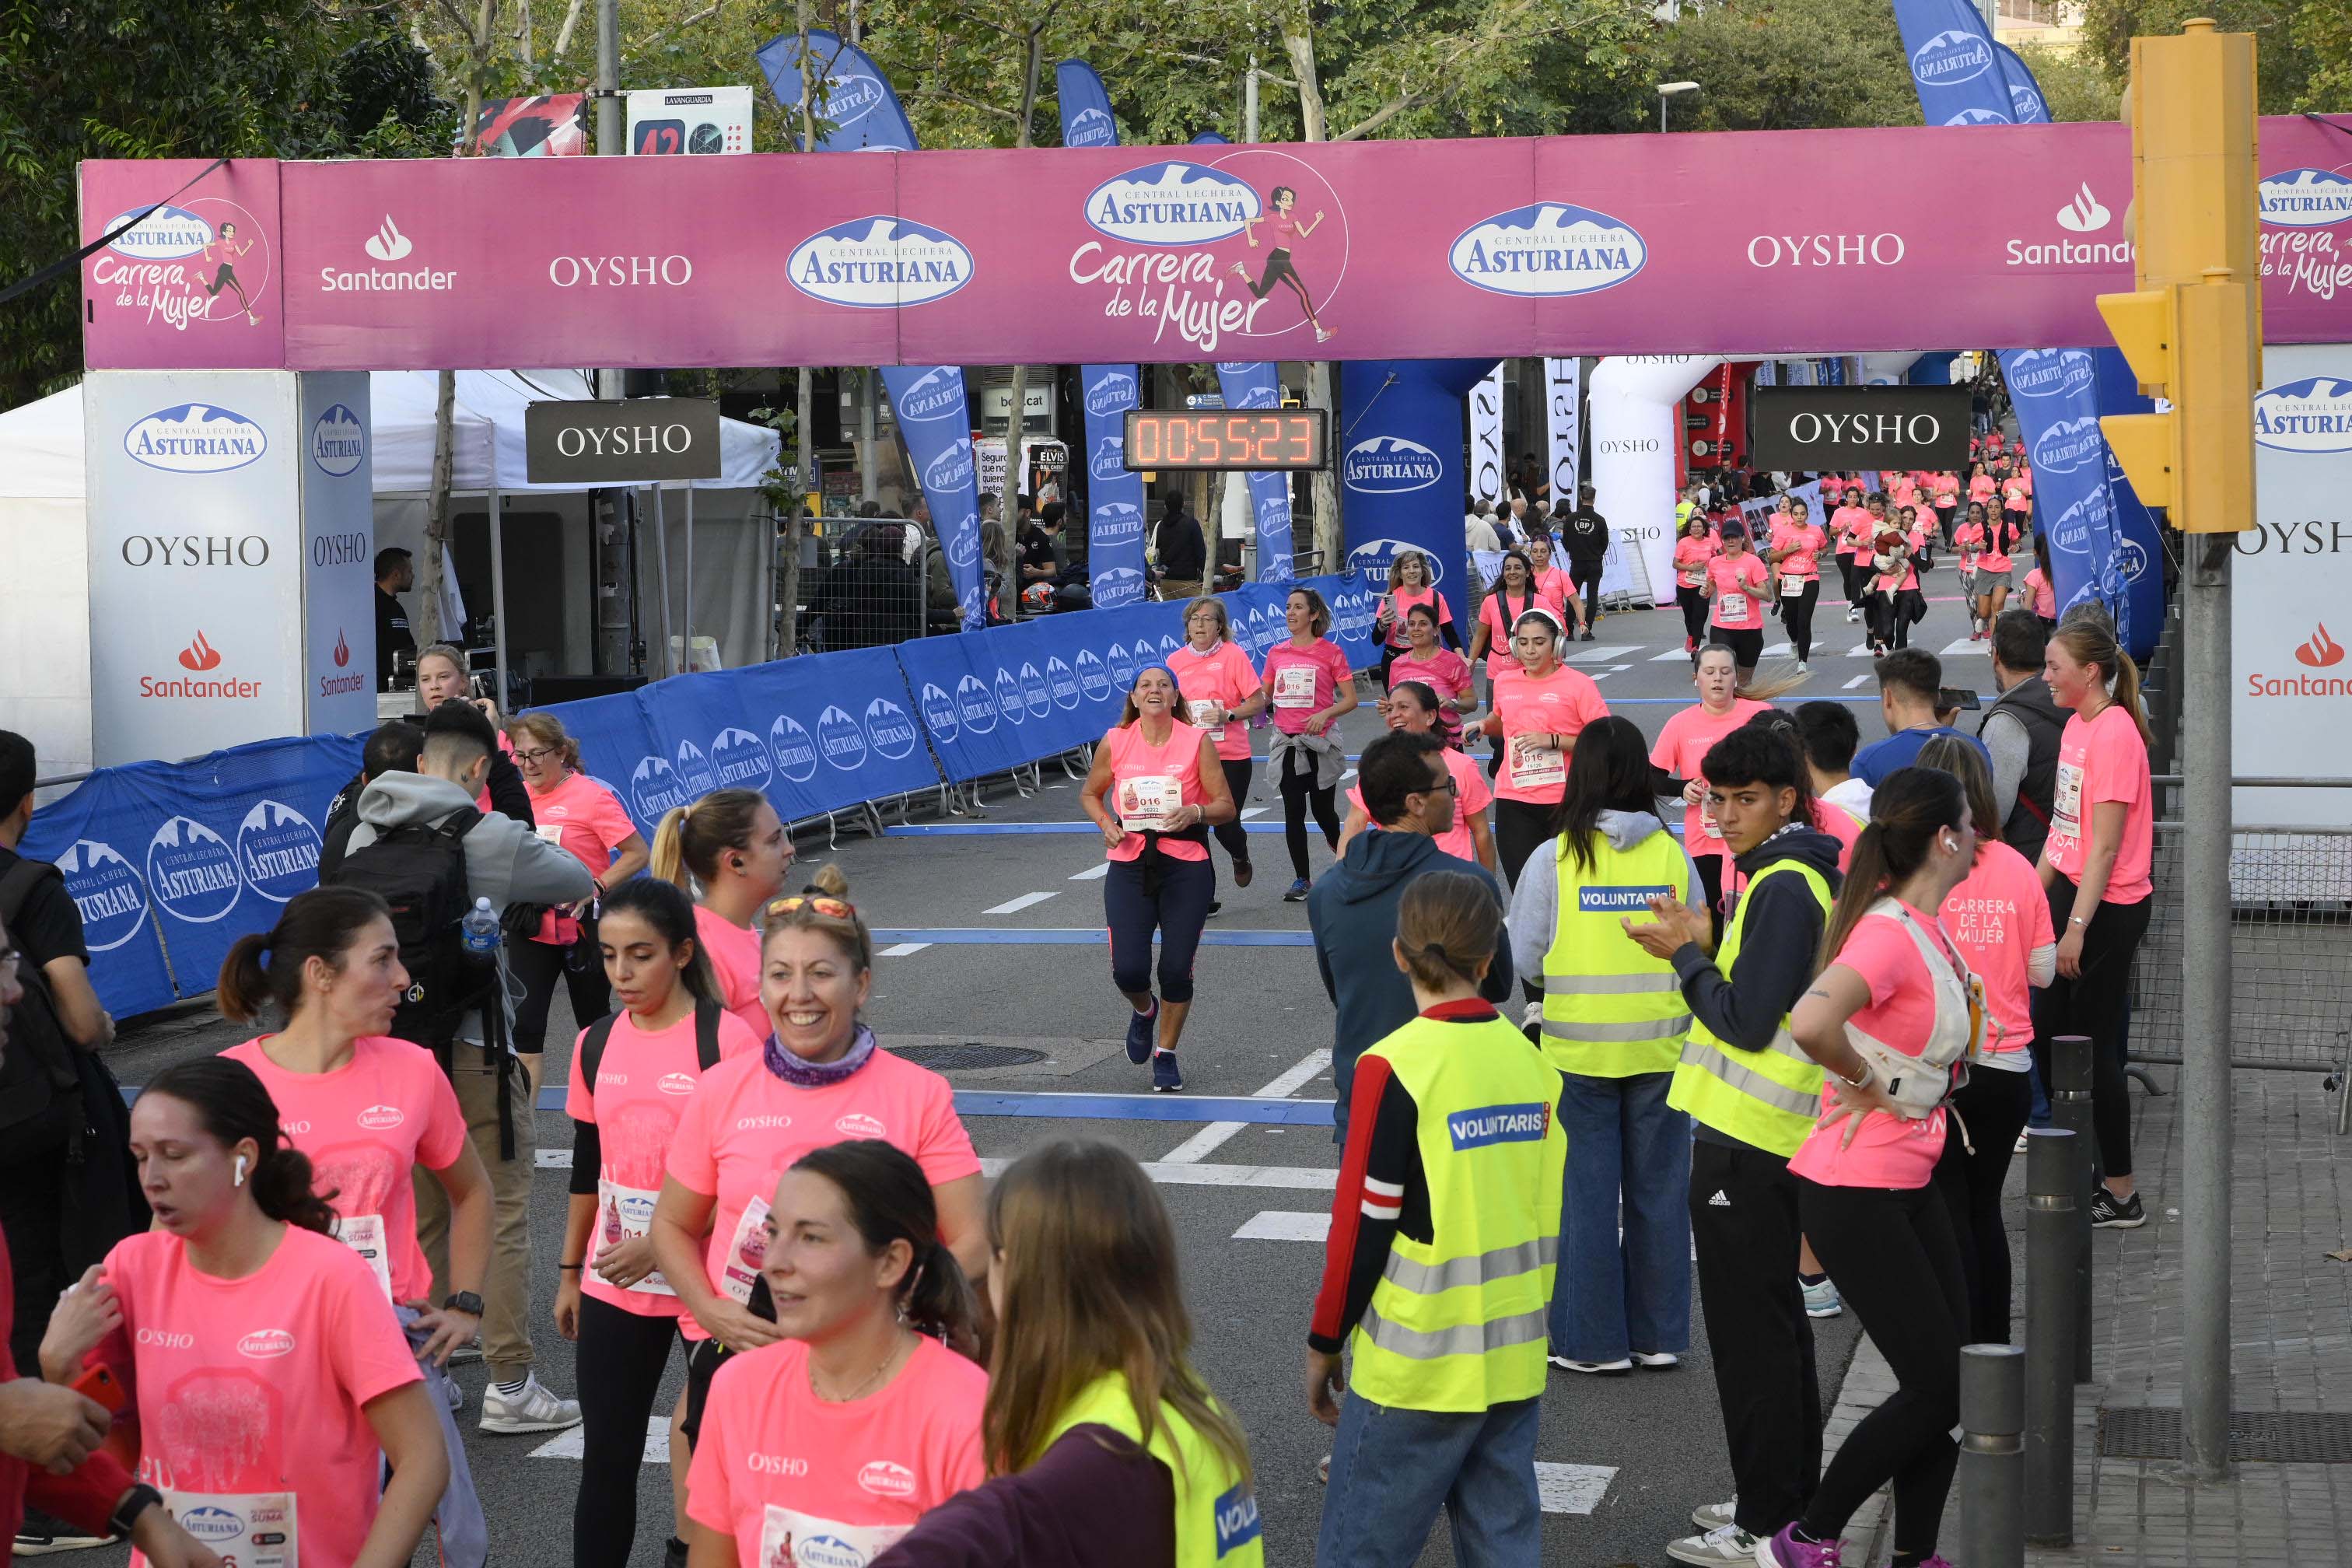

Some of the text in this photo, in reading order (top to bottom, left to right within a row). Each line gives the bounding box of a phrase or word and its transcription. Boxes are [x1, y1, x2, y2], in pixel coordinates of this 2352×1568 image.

[1125, 189, 1242, 199] CENTRAL LECHERA
[1097, 194, 1245, 225] ASTURIANA
[111, 224, 205, 246] ASTURIANA
[1494, 233, 1625, 245] CENTRAL LECHERA
[829, 247, 953, 257] CENTRAL LECHERA
[1464, 238, 1632, 274] ASTURIANA
[1747, 233, 1905, 268] OYSHO
[93, 256, 185, 285] Carrera
[549, 254, 692, 286] OYSHO
[801, 250, 960, 284] ASTURIANA
[1069, 241, 1215, 285] Carrera
[2277, 255, 2291, 275] la
[321, 266, 457, 292] Santander
[116, 282, 220, 331] de la Mujer
[1104, 278, 1270, 352] de la Mujer
[1137, 418, 1310, 461] 00:55:23
[1790, 412, 1941, 444] OYSHO
[135, 429, 257, 455] ASTURIANA
[316, 430, 361, 458] ASTURIANA
[557, 424, 692, 457] OYSHO
[1600, 439, 1659, 454] OYSHO
[1040, 451, 1064, 461] ELVIS
[982, 465, 995, 474] que
[1347, 460, 1435, 481] ASTURIANA
[122, 535, 270, 566] OYSHO
[313, 532, 366, 567] OYSHO
[140, 676, 262, 698] Santander
[320, 671, 365, 698] Santander
[775, 743, 814, 768] ASTURIANA
[822, 733, 864, 757] ASTURIANA
[1524, 753, 1543, 762] 016
[716, 755, 772, 786] ASTURIANA
[1140, 797, 1160, 806] 016
[253, 828, 311, 849] CENTRAL LECHERA
[165, 847, 226, 867] CENTRAL LECHERA
[247, 842, 320, 882] ASTURIANA
[156, 859, 237, 901] ASTURIANA
[1947, 898, 2016, 915] CARRERA
[1960, 914, 2002, 928] DE LA
[1955, 929, 2004, 943] MUJER
[737, 1115, 793, 1130] OYSHO
[1452, 1113, 1542, 1140] VOLUNTARIS
[1708, 1196, 1731, 1206] adidas
[747, 1452, 808, 1476] OYSHO
[187, 1517, 240, 1533] ASTURIANA
[251, 1513, 283, 1523] SUMA
